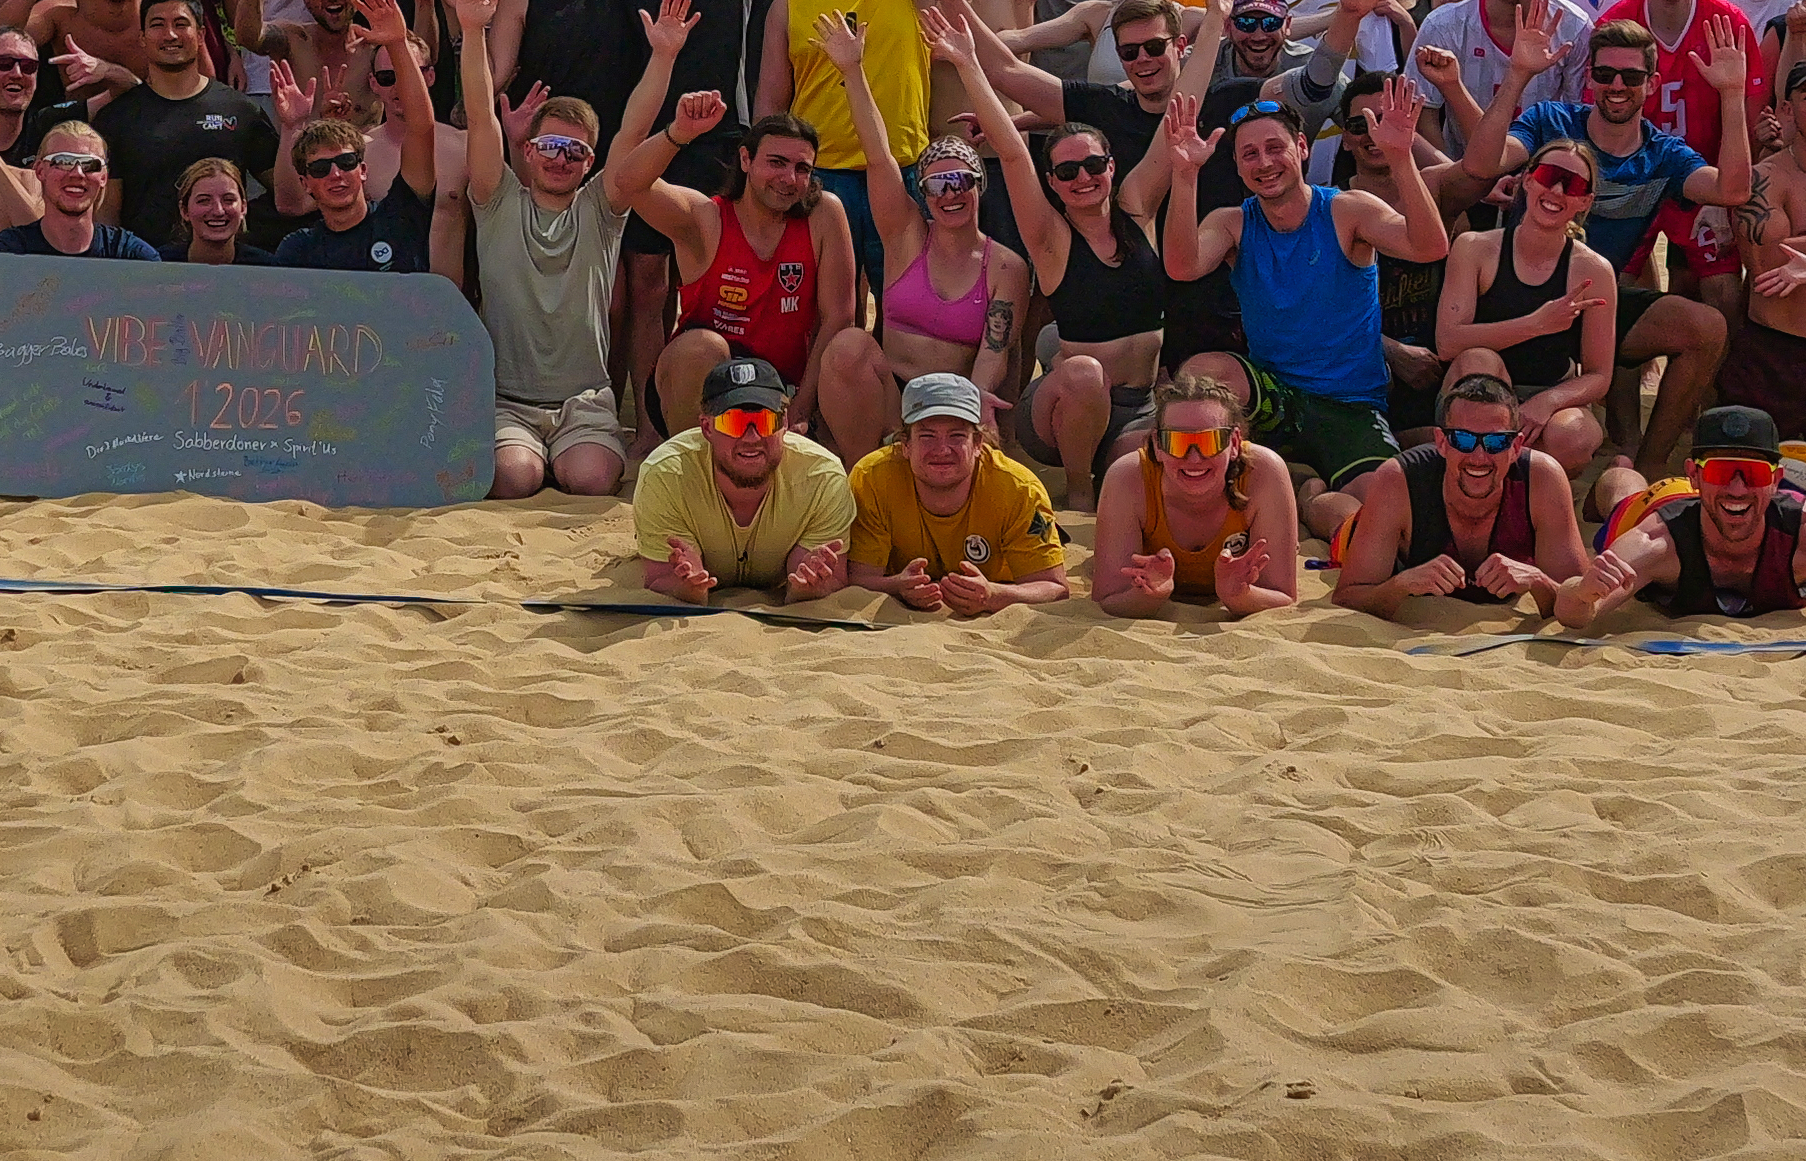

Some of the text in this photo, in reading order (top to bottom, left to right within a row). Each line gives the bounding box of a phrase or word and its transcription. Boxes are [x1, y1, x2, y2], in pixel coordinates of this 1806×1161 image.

[1661, 79, 1687, 138] 5
[780, 295, 800, 314] MK
[85, 314, 383, 377] VIBE VANGUARD
[209, 382, 306, 430] 2026
